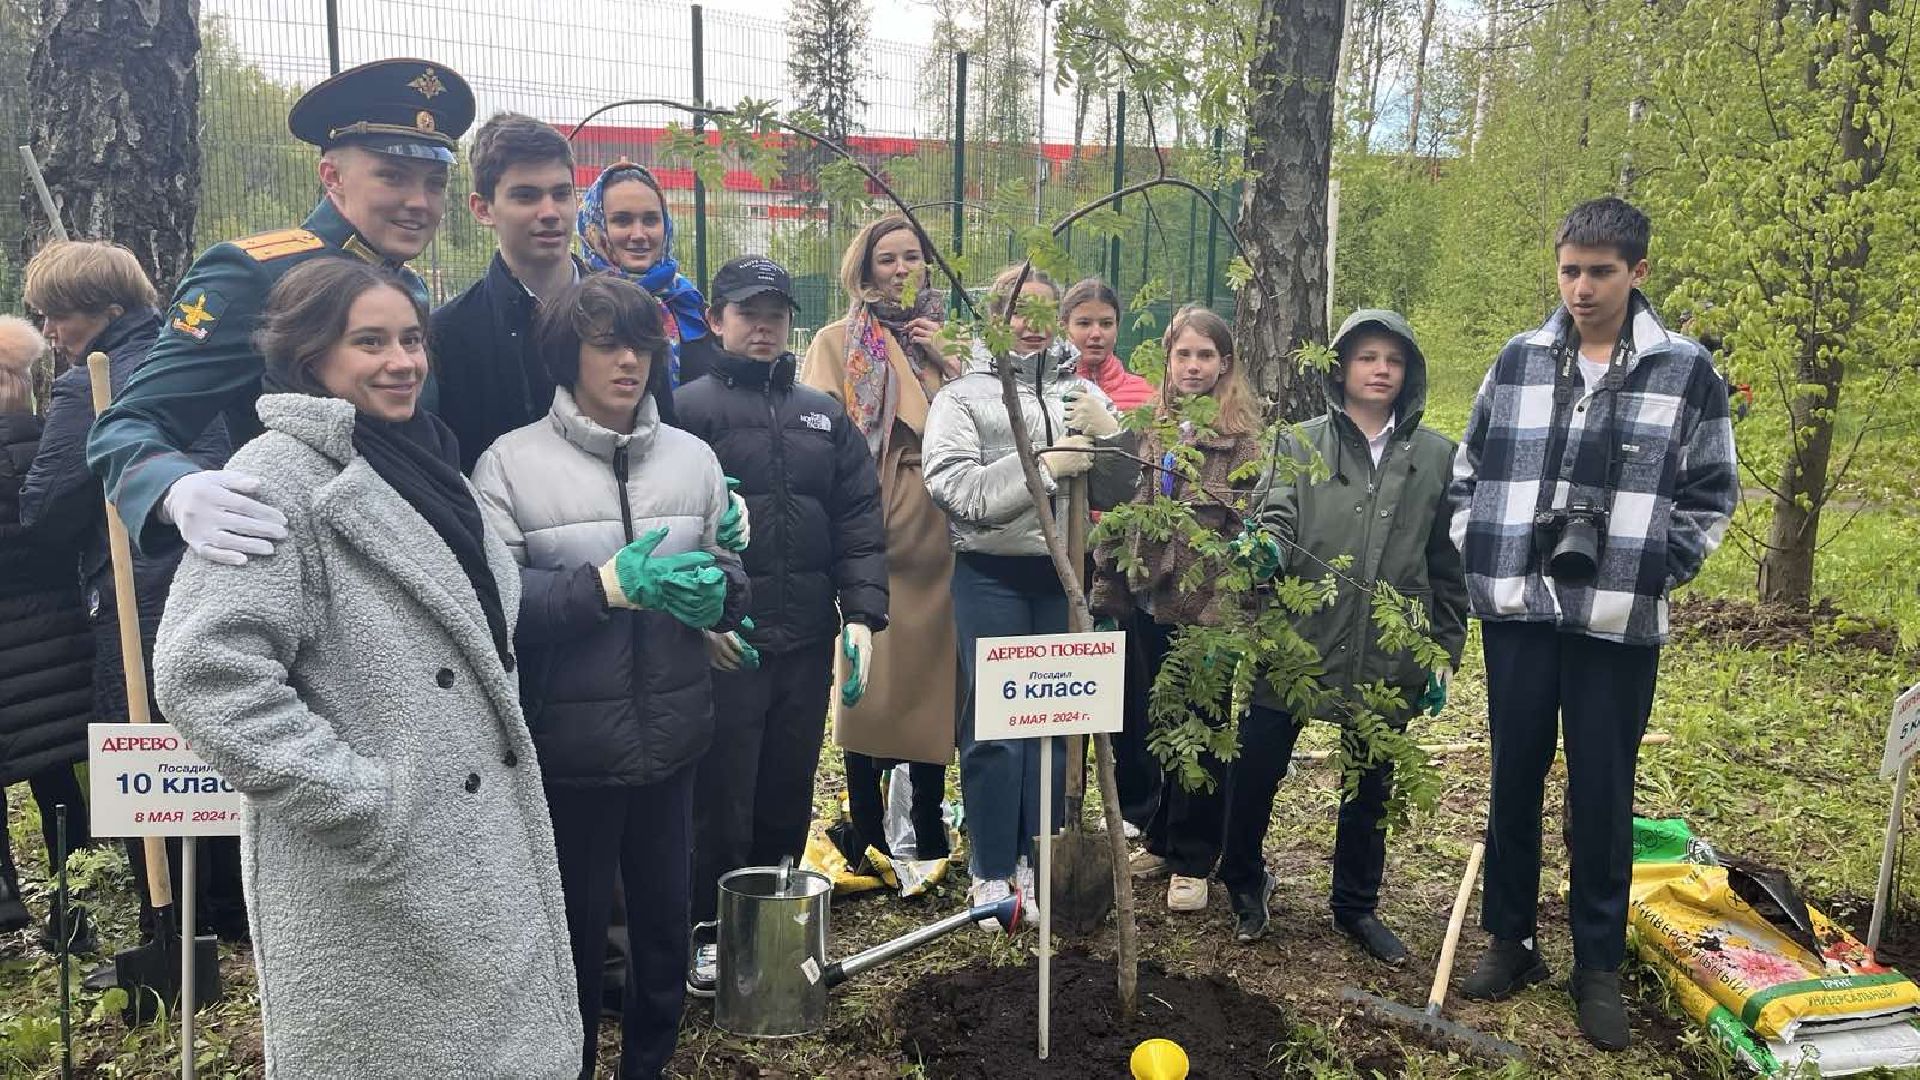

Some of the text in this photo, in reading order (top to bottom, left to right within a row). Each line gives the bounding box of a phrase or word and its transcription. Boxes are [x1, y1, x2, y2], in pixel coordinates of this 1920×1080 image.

[986, 642, 1115, 661] ДЕРЕВО ПОБЕДЫ
[1029, 671, 1072, 680] Посадил
[1003, 680, 1097, 700] 6 класс
[1009, 716, 1017, 726] 8
[1019, 714, 1047, 725] МАЯ
[1052, 711, 1079, 723] 2024
[102, 737, 178, 752] ДЕРЕВО
[116, 773, 235, 795] 10 клас
[134, 811, 145, 823] 8
[148, 811, 184, 823] МАЯ
[192, 810, 226, 821] 2024
